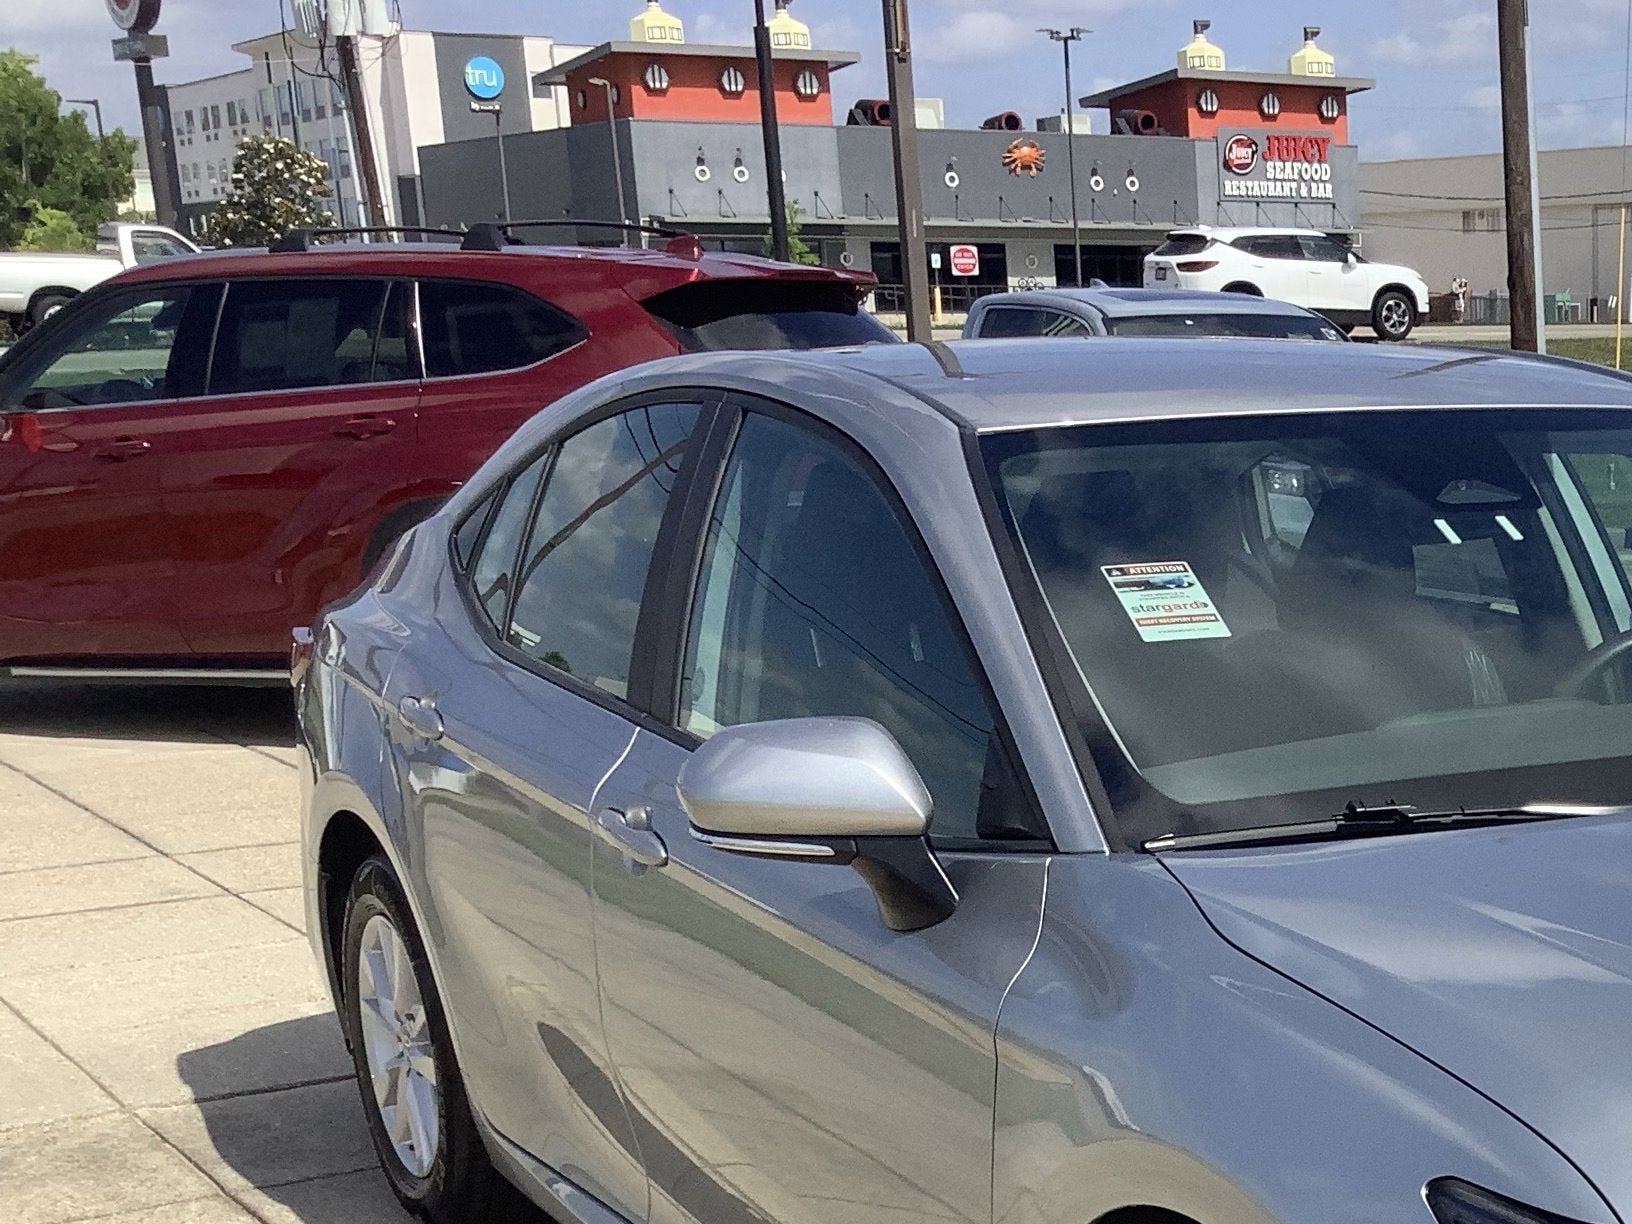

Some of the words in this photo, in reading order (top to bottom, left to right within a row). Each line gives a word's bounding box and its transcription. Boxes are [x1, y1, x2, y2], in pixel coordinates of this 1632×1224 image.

[465, 63, 498, 87] tru
[1262, 135, 1331, 162] JUICY
[1266, 161, 1331, 181] SEAFOOD
[1224, 180, 1298, 198] RESTAURANT
[1300, 183, 1309, 198] &
[1310, 183, 1333, 199] BAR
[1130, 564, 1185, 575] ATTENTION
